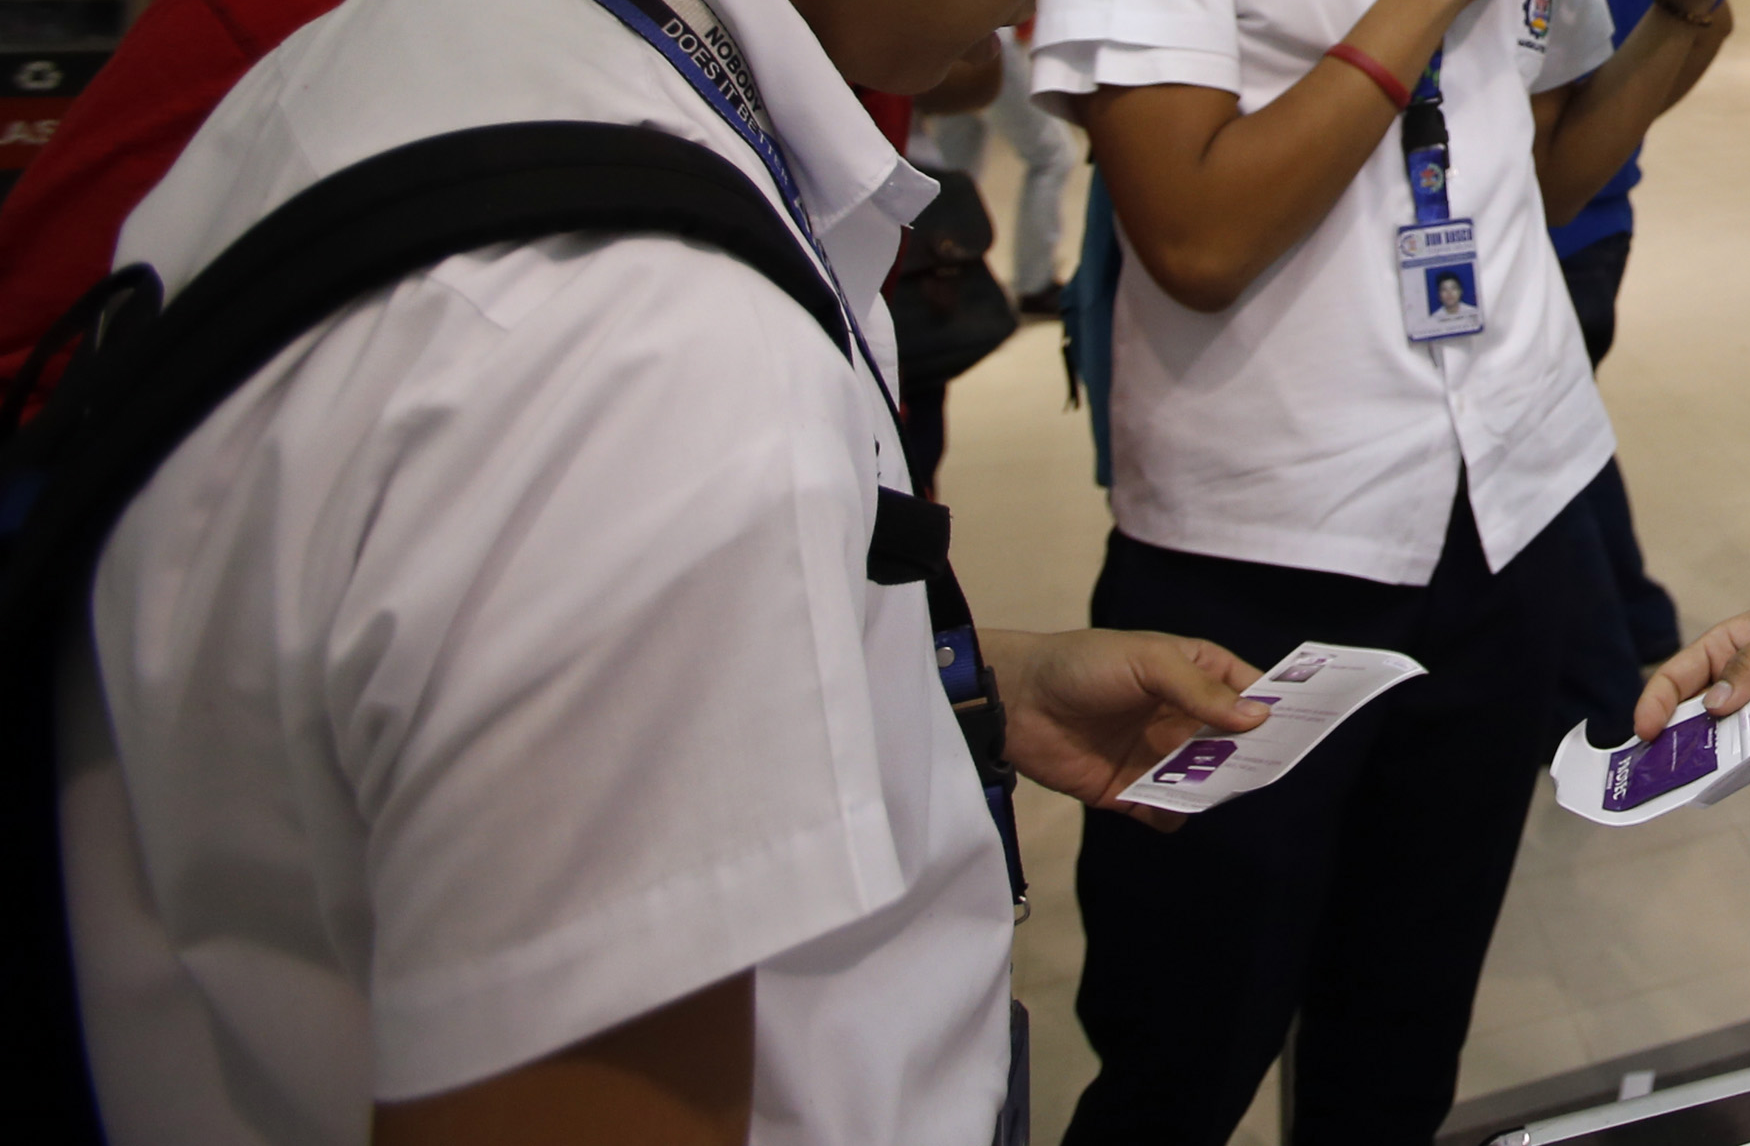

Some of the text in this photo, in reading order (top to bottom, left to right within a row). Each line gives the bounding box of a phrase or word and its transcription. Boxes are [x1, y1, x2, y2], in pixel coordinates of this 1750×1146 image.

[661, 17, 789, 187] DOES IT BETTER
[704, 25, 762, 114] NOBODY
